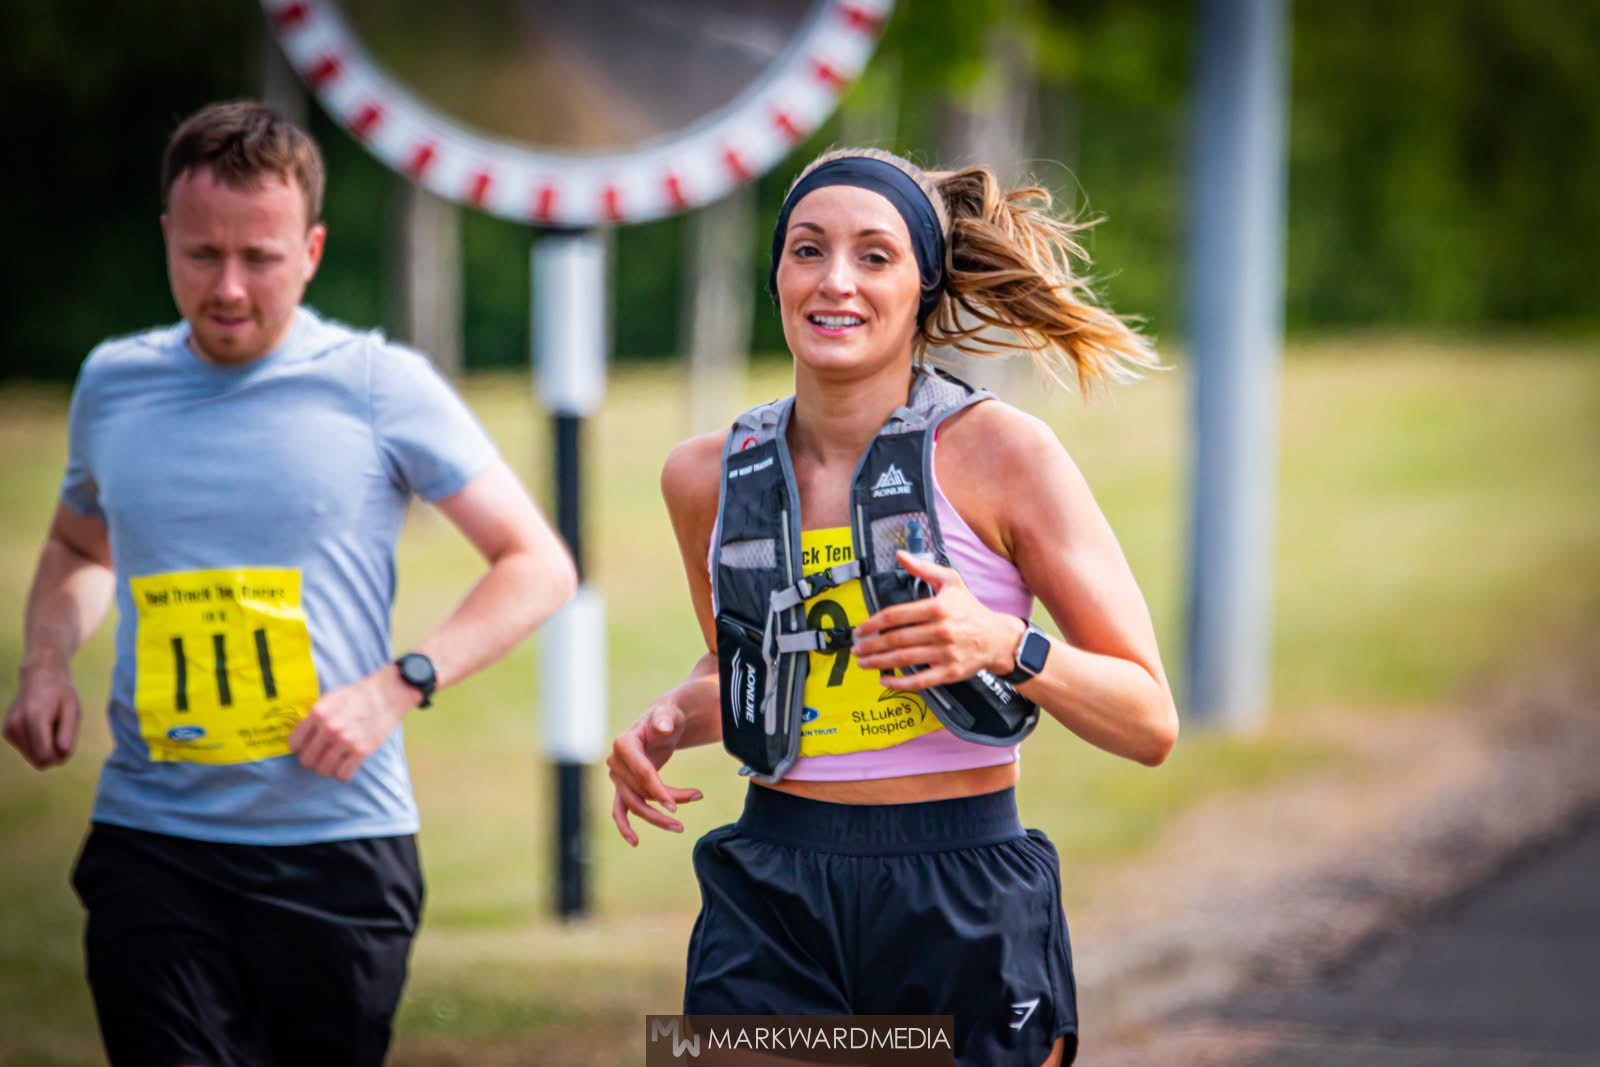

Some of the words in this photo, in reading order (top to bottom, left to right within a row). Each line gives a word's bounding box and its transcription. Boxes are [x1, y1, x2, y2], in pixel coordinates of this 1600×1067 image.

[802, 547, 820, 566] ck
[825, 545, 851, 563] Ten
[171, 628, 277, 713] 111
[870, 703, 912, 721] Luke's
[814, 727, 838, 737] TRUST
[860, 717, 915, 736] Hospice
